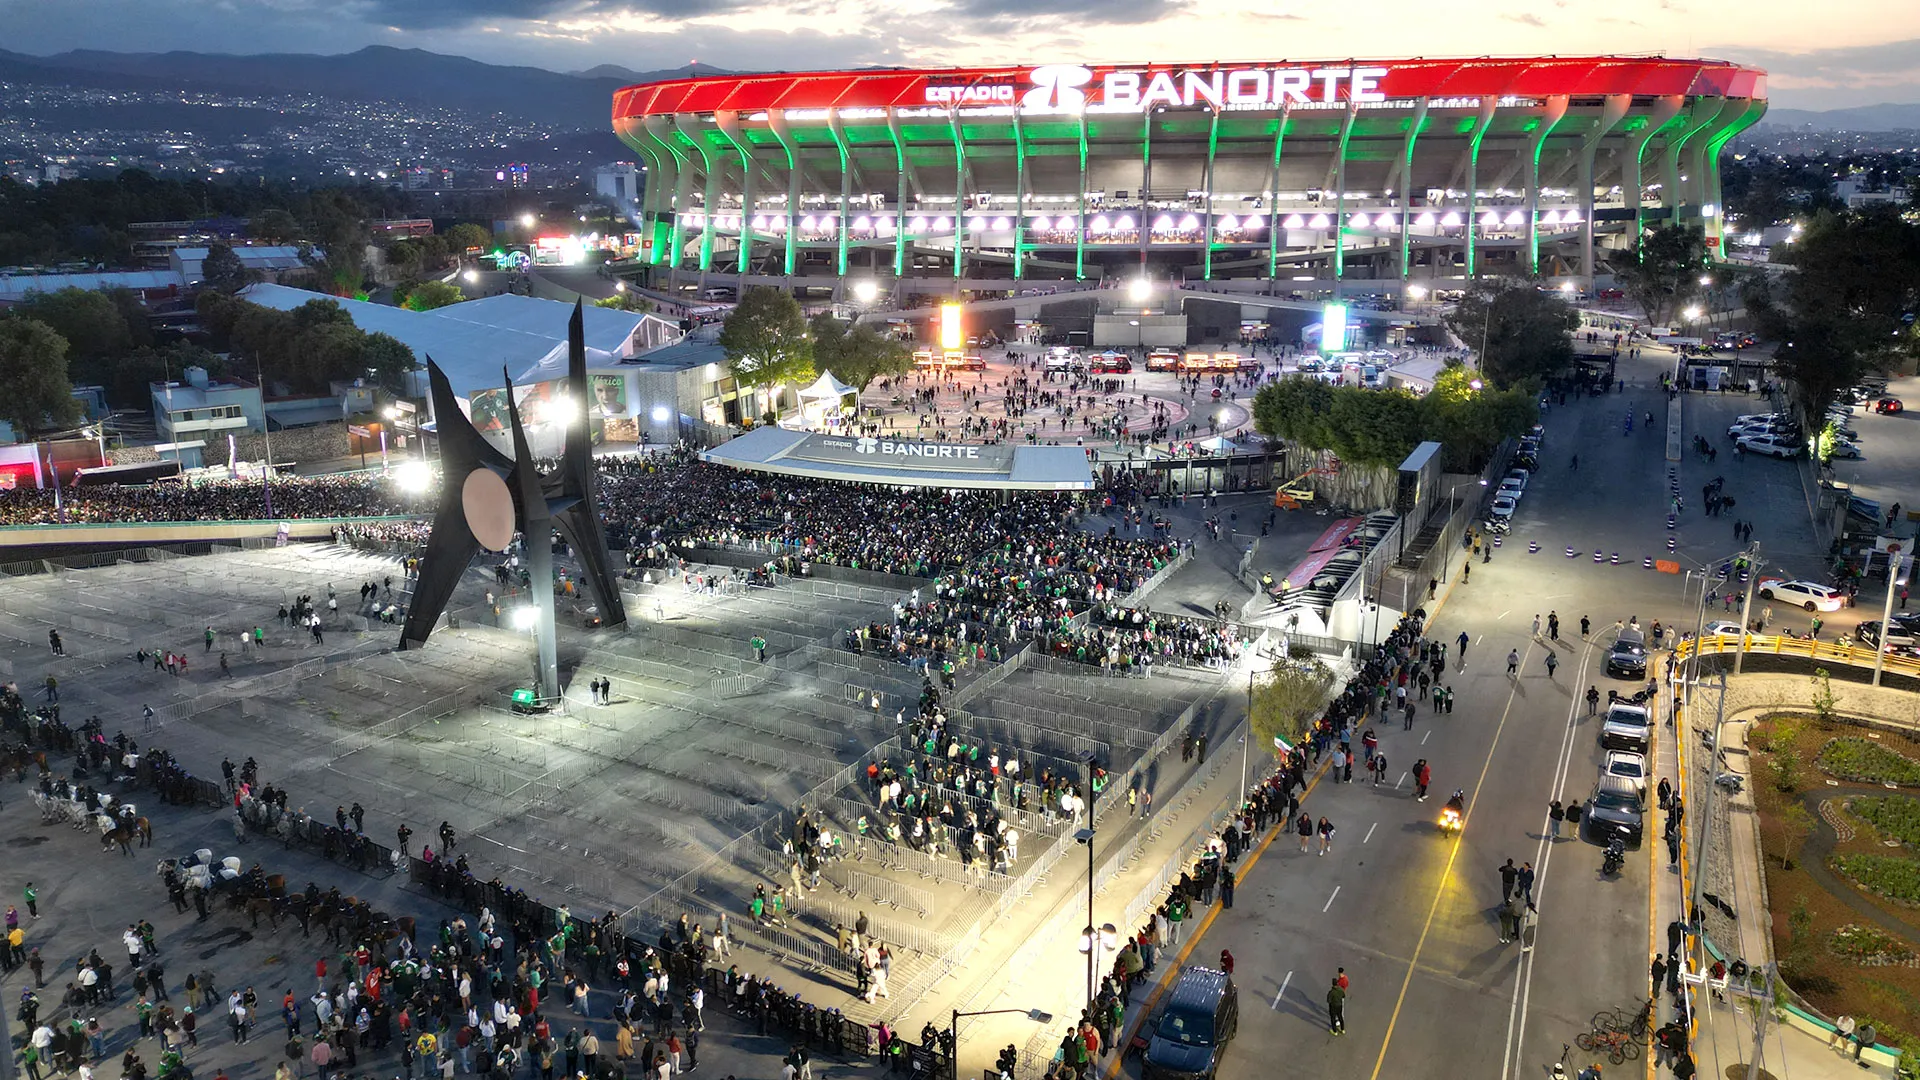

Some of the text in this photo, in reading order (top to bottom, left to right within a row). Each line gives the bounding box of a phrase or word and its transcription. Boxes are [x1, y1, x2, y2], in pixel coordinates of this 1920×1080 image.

[925, 67, 1388, 106] ESTADIO BANORTE
[881, 442, 979, 459] BANORTE
